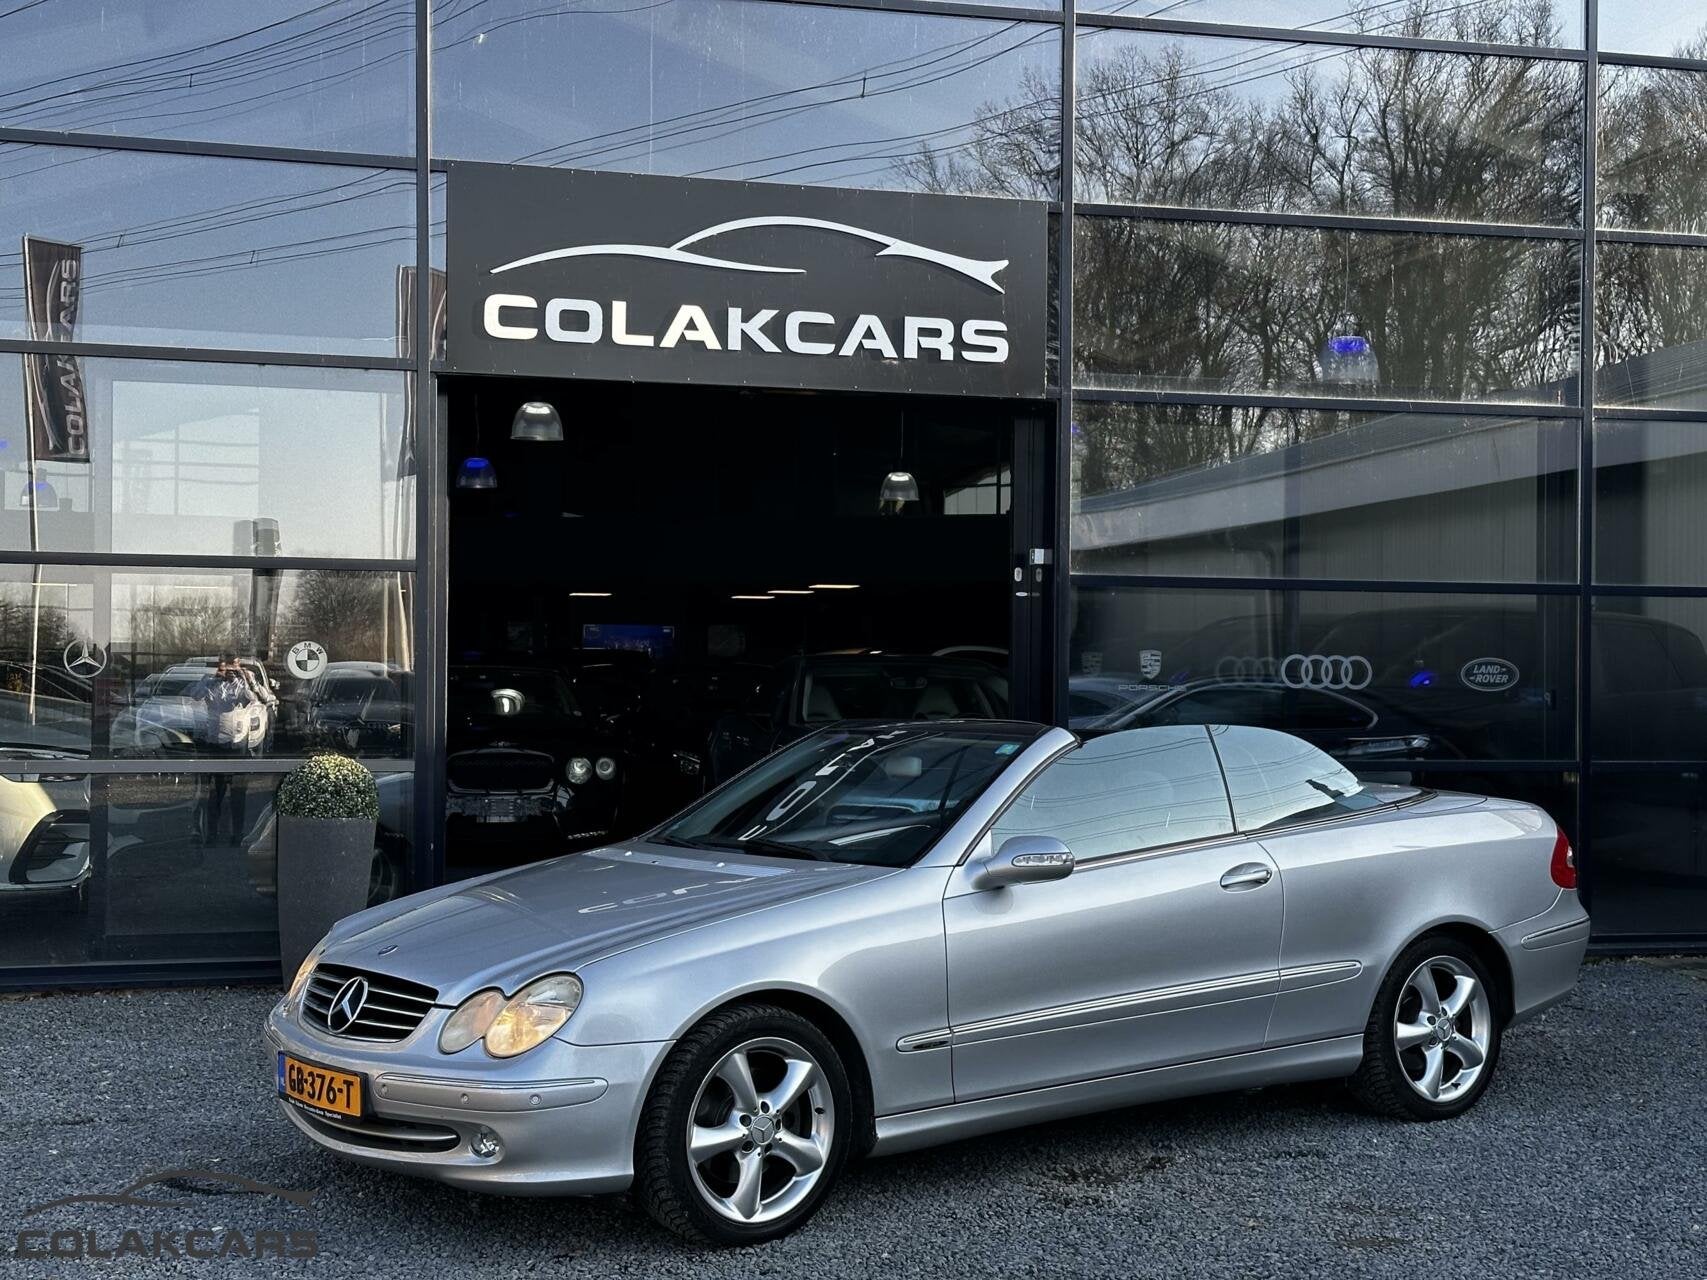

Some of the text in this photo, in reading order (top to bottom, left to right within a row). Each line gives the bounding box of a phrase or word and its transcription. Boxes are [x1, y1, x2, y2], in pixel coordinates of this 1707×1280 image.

[483, 293, 1009, 363] COLAKCARS
[291, 642, 324, 655] BMW
[288, 1064, 354, 1109] GB-376-T
